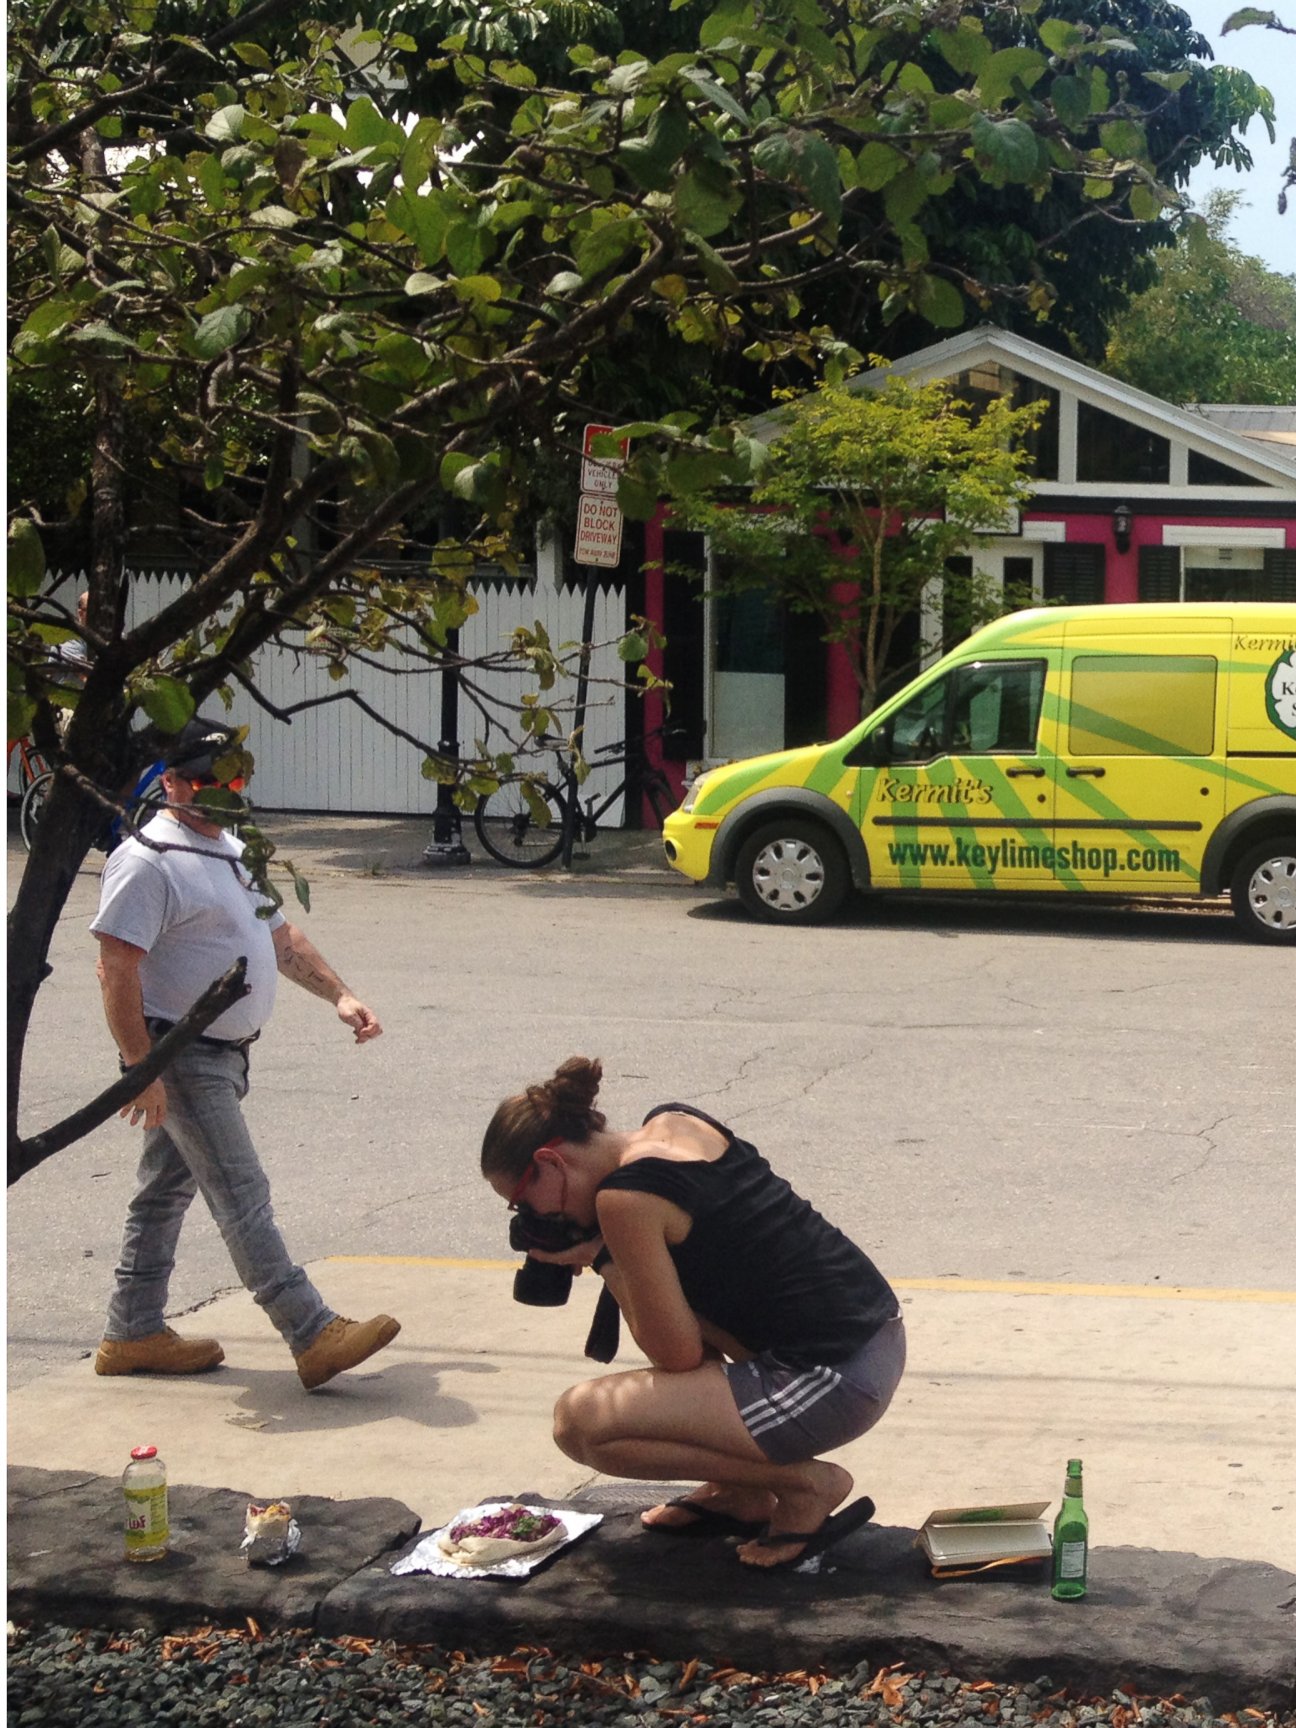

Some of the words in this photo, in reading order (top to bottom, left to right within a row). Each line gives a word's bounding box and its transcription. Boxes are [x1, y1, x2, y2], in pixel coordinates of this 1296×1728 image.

[588, 468, 618, 480] VEHICLE
[583, 503, 598, 515] DO
[599, 505, 618, 518] NOT
[583, 517, 615, 531] BLOCK
[580, 530, 618, 545] DRIVEWAY
[876, 777, 993, 805] Kermit's
[888, 836, 1181, 878] www.keylimeshop.com
